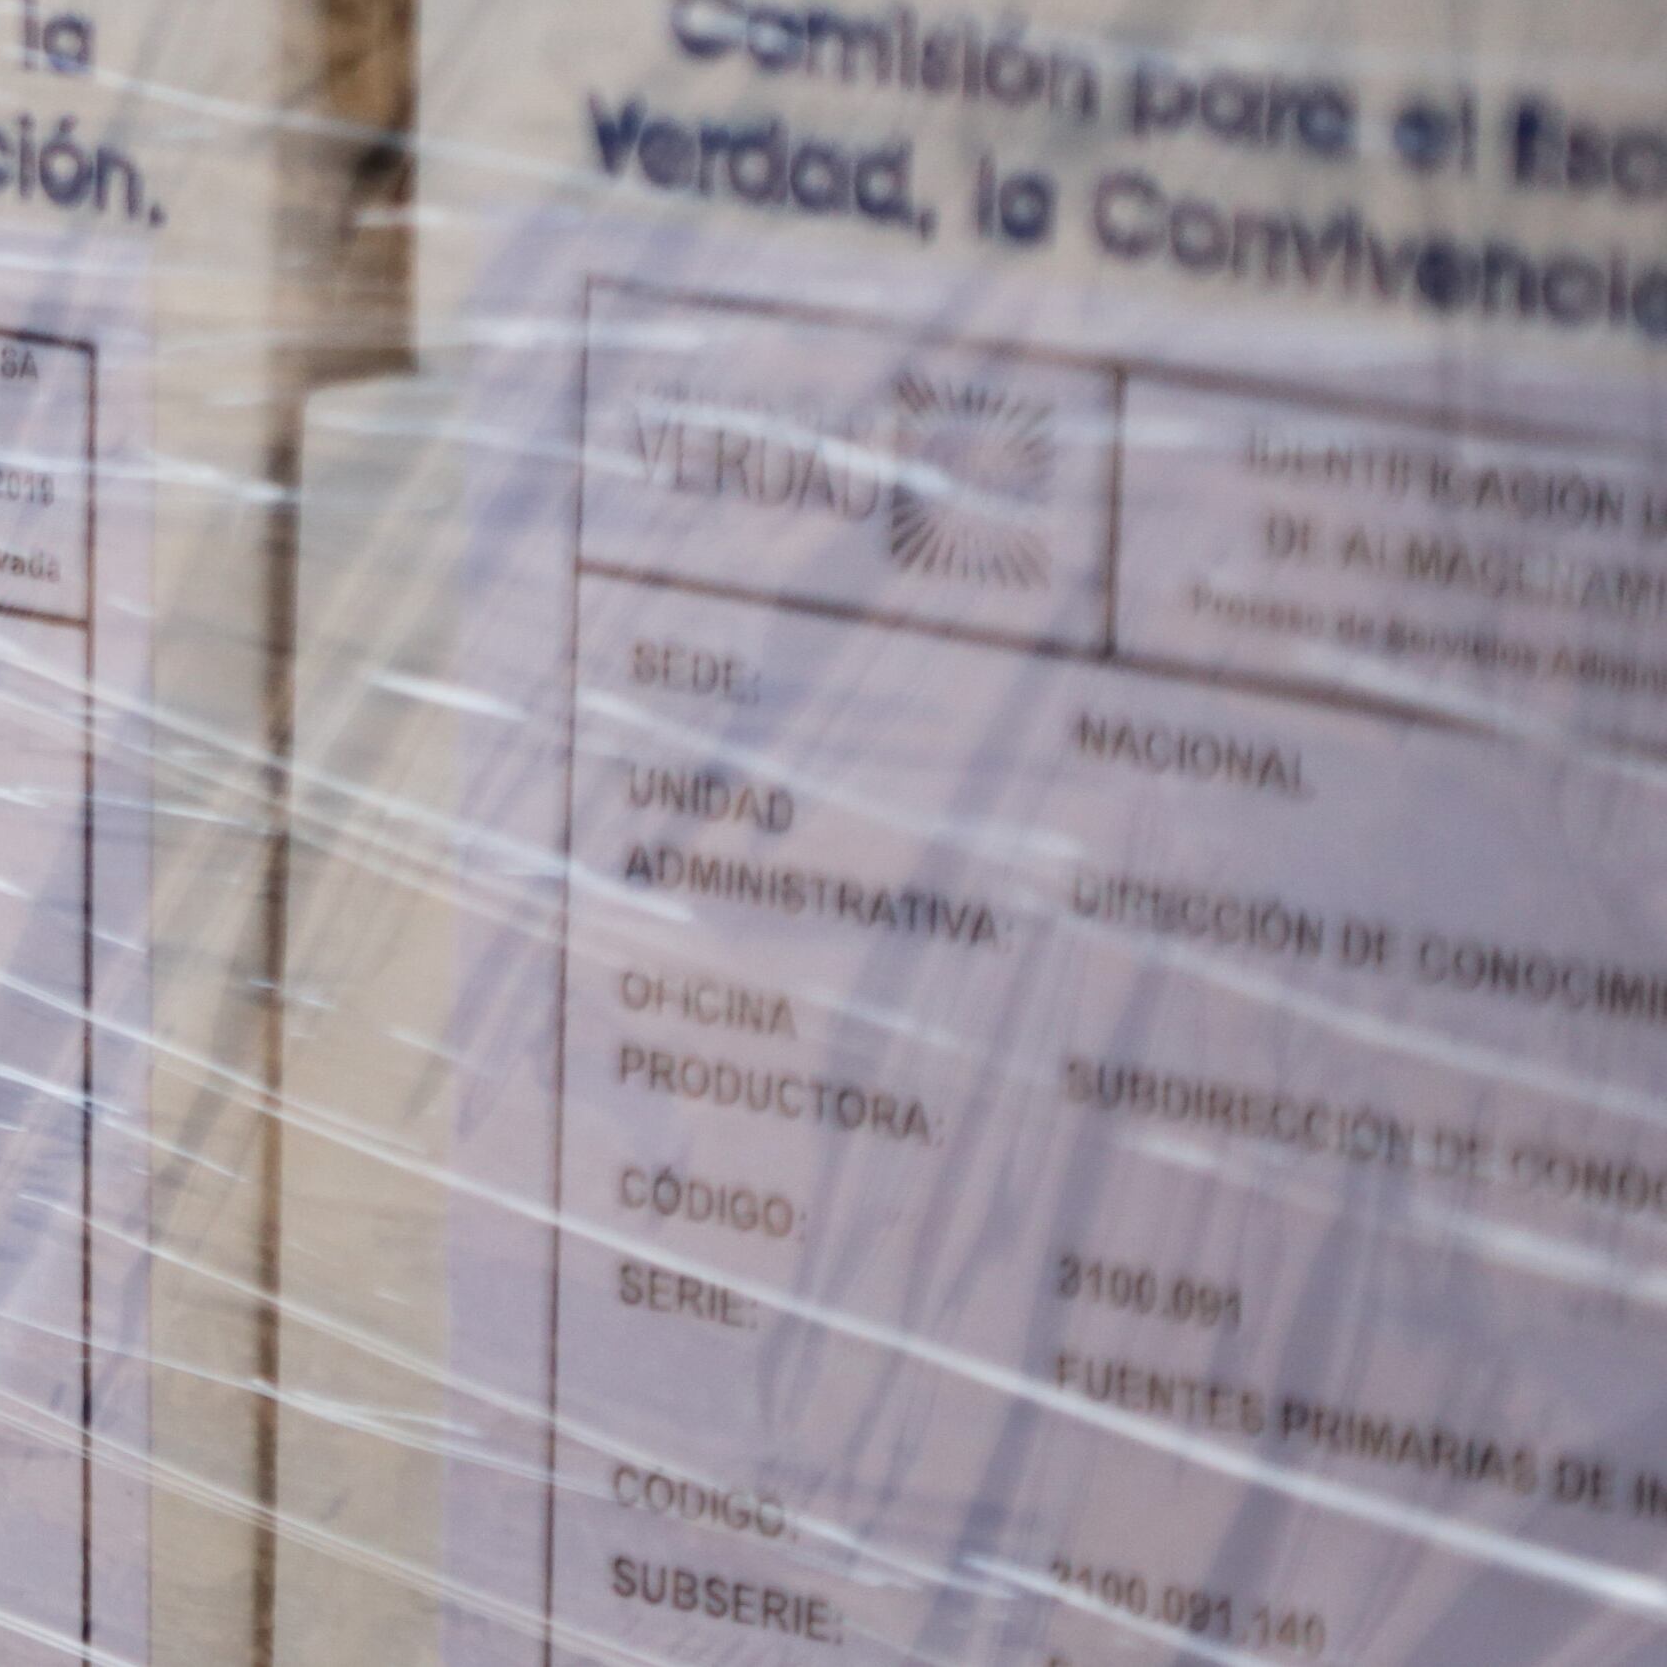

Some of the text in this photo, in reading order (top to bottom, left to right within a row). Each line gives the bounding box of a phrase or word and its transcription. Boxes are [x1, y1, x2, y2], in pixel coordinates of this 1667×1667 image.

[587, 94, 935, 242] Verdad,
[974, 155, 1058, 247] la
[1388, 81, 1479, 174] el
[631, 639, 1313, 798] SEDE: NACIONAL
[625, 766, 796, 835] UNIDAD
[622, 842, 1015, 952] ADMINISTRATIVA:
[617, 1044, 947, 1150] PRODUCTORA:
[616, 1158, 809, 1244] CÓDIGO:
[1280, 1398, 1538, 1500] PRIMARIAS
[612, 1551, 847, 1648] SUBSERIE:
